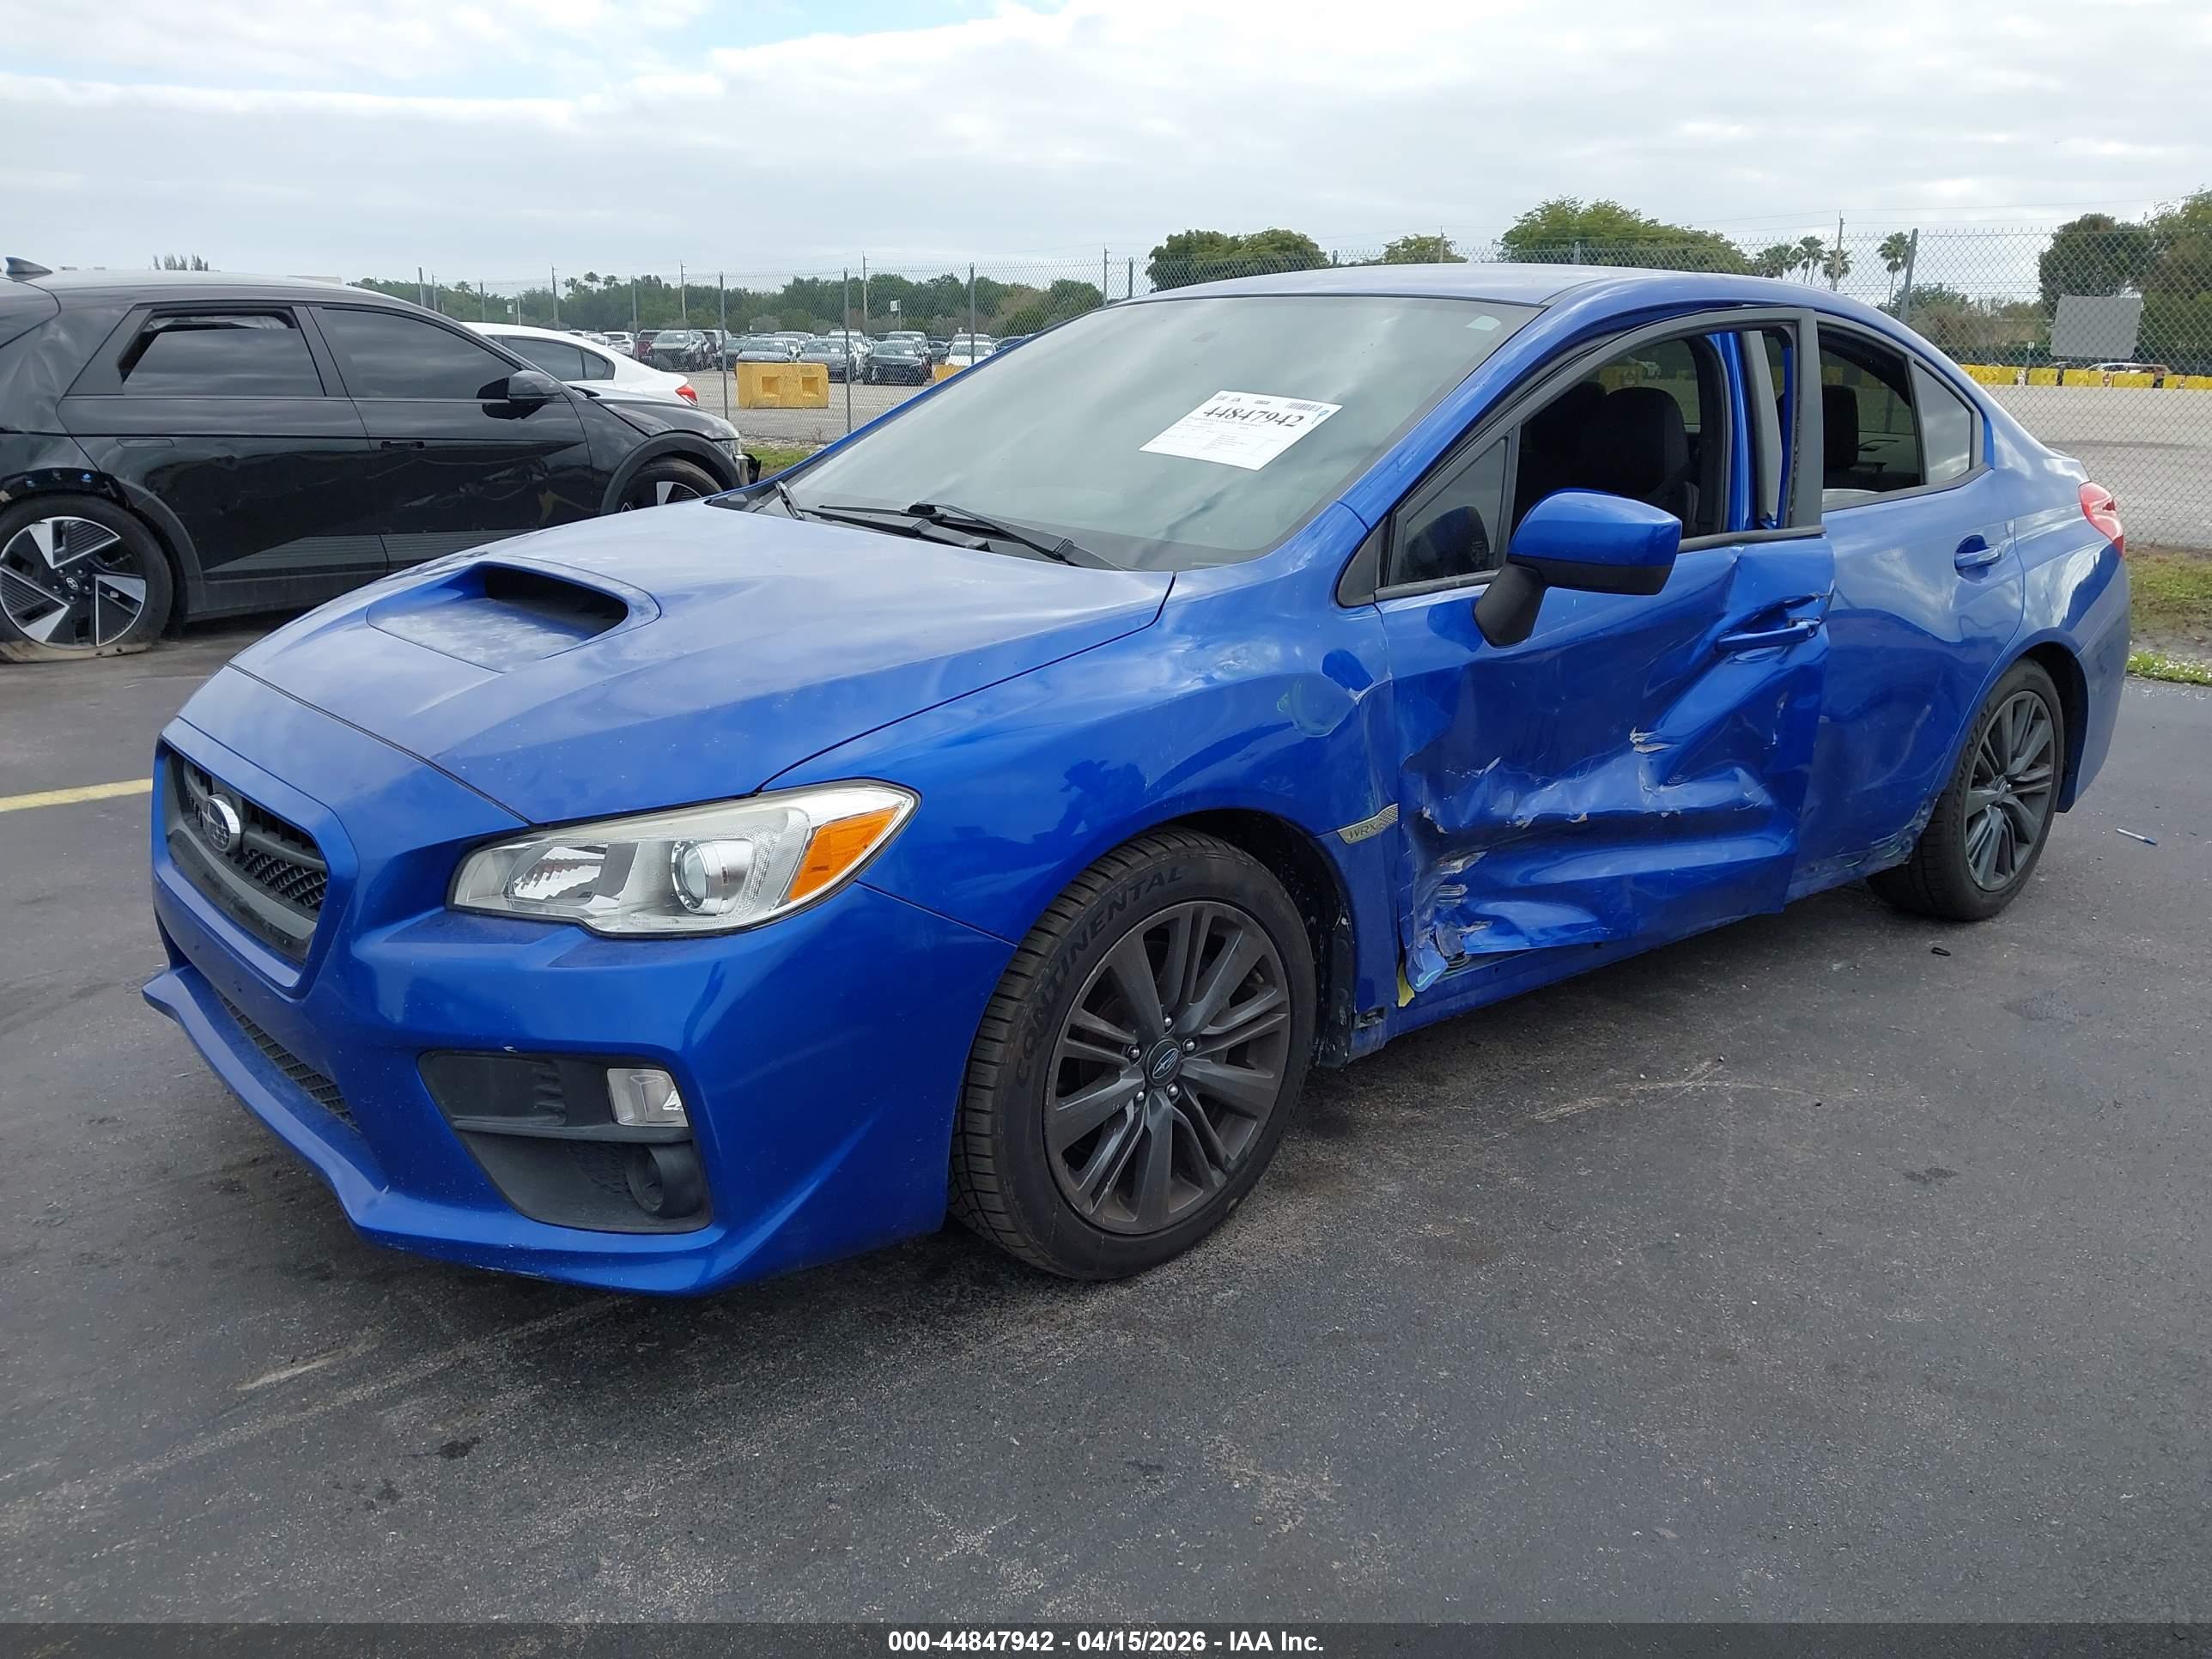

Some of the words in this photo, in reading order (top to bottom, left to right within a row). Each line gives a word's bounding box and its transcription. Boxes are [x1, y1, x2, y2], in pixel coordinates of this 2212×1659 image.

[1203, 405, 1304, 428] 44847942
[1348, 823, 1377, 839] WRX
[1017, 866, 1184, 1085] CONTINENTAL
